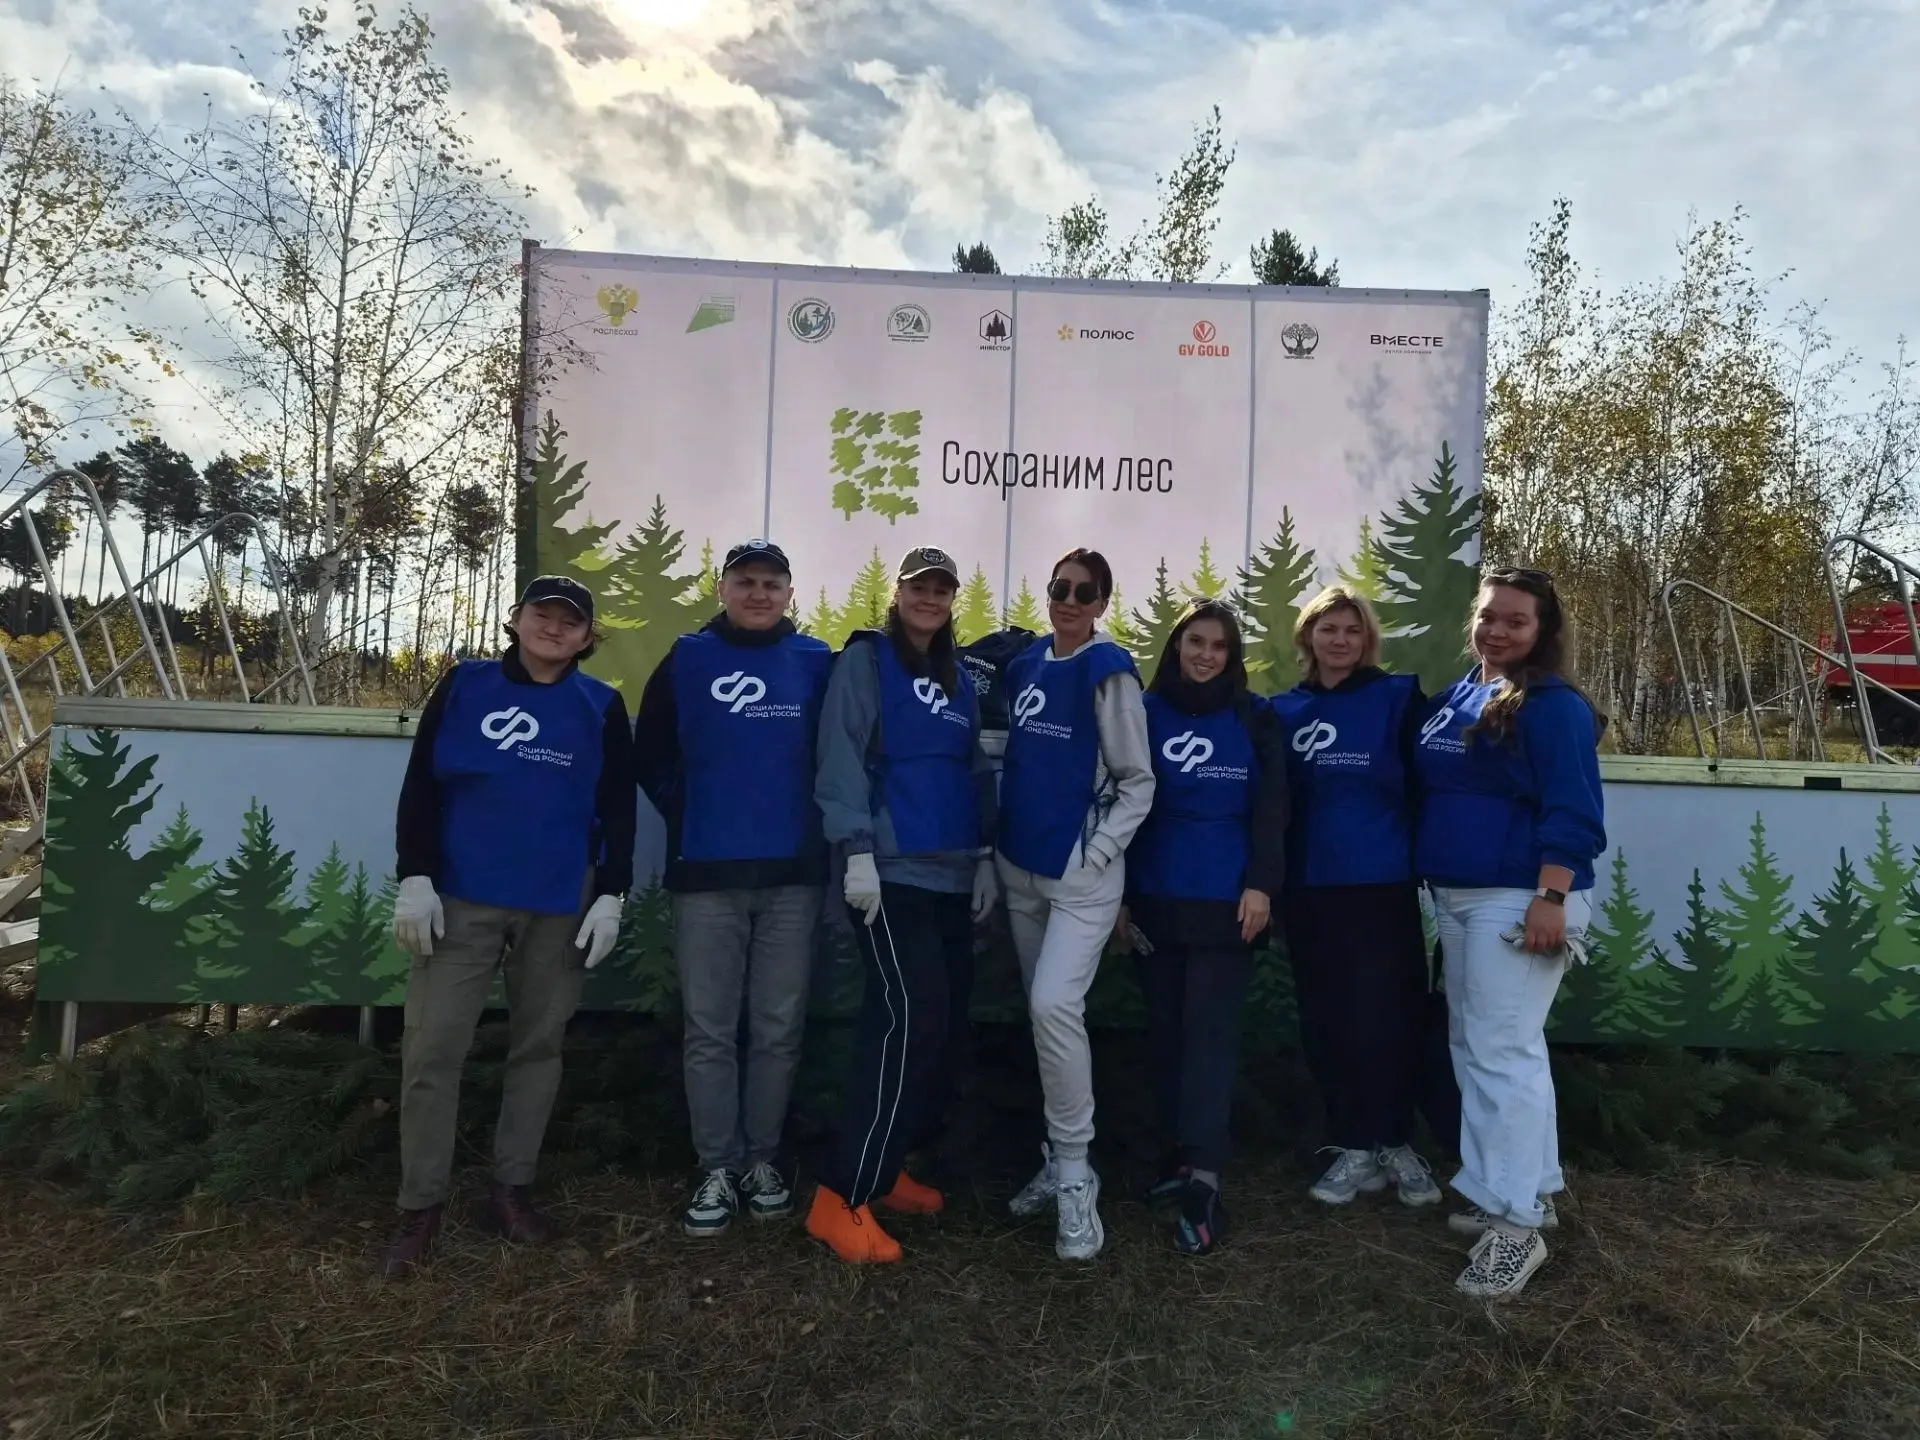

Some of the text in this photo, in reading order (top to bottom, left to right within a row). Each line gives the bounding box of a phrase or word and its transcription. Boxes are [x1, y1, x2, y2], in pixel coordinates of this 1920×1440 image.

[1080, 329, 1135, 340] ПОЛЮС
[1370, 334, 1444, 347] ВМЕСТЕ
[1178, 343, 1230, 357] GV GOLD
[942, 440, 1173, 501] Сохраним лес
[745, 704, 801, 712] СОЦИАЛЬНЫЙ
[517, 751, 572, 767] ФОНД РОССИИ
[518, 744, 573, 761] СОЦИАЛЬНЫЙ
[1317, 752, 1370, 760] СОЦИАЛЬНЫЙ
[1197, 766, 1248, 774] СОЦИАЛЬНЫЙ
